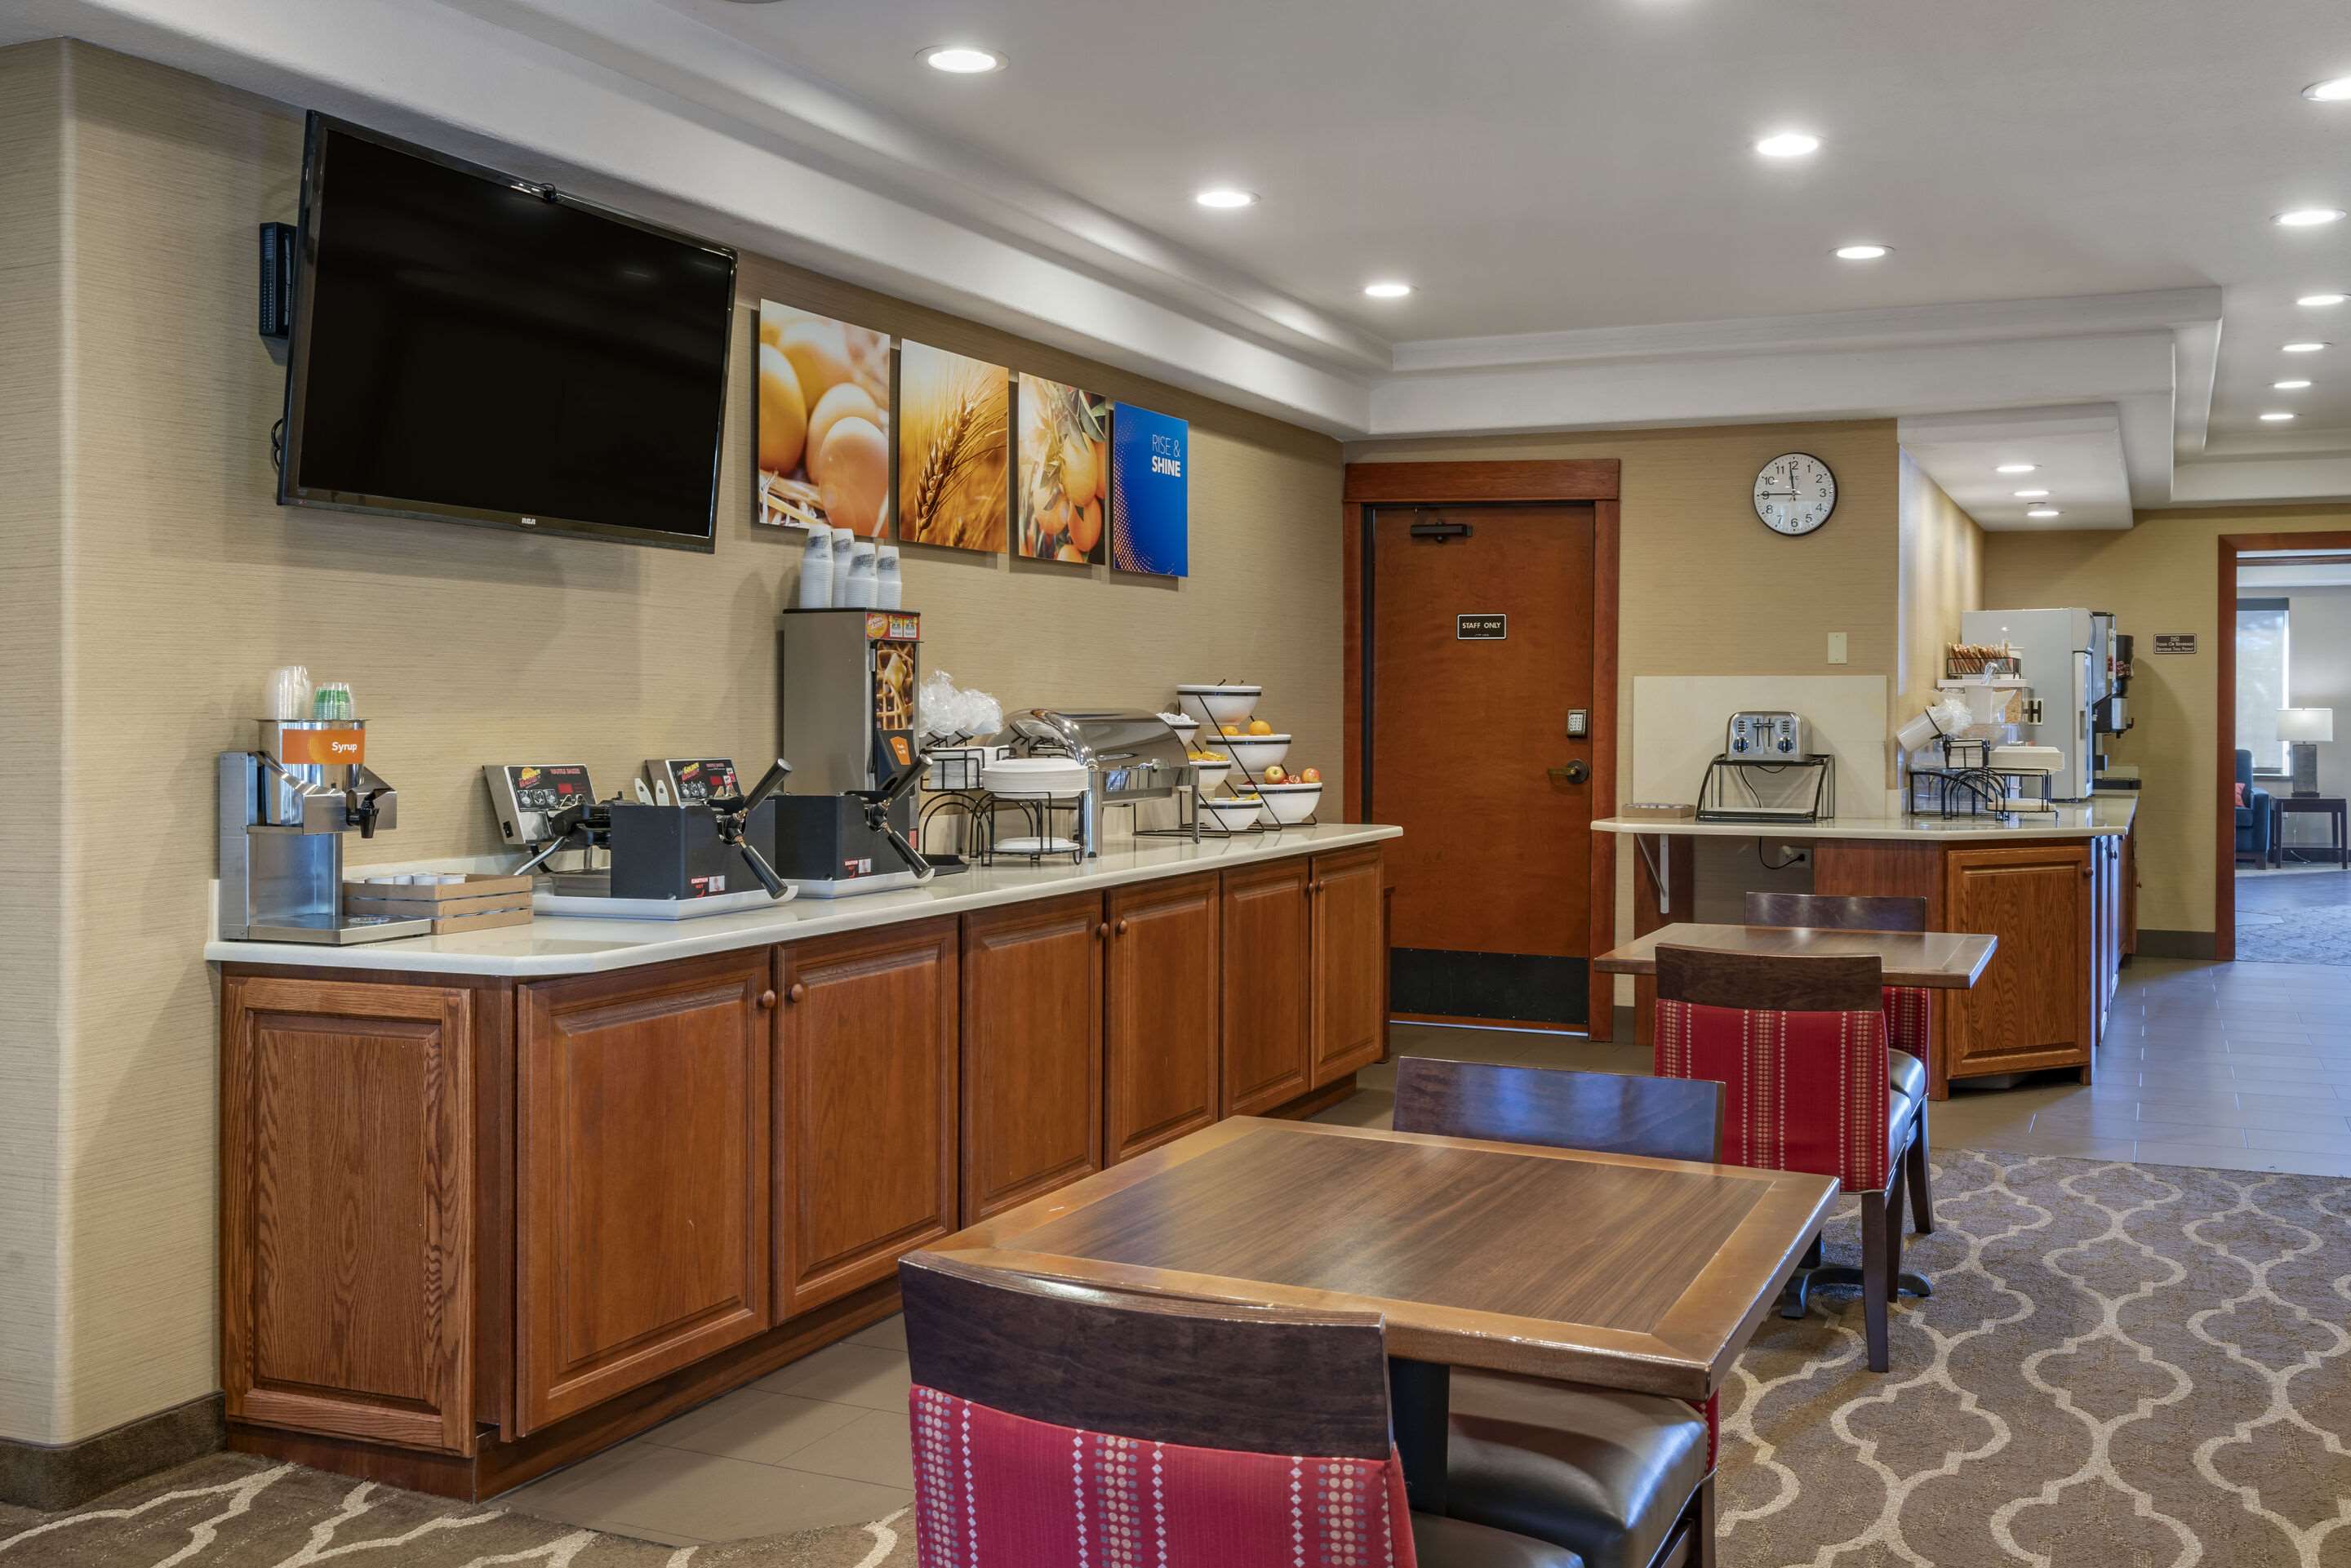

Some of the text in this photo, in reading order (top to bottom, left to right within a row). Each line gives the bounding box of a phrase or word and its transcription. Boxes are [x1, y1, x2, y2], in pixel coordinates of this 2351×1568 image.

[1152, 434, 1180, 458] RISE &
[1152, 455, 1181, 478] SHINE
[1776, 465, 1784, 475] 11
[1789, 460, 1799, 470] 12
[1764, 476, 1775, 486] 10
[1815, 474, 1823, 483] 2
[1762, 491, 1770, 500] 9
[1819, 488, 1827, 498] 3
[1766, 504, 1774, 514] 8
[1815, 503, 1823, 512] 4
[522, 517, 536, 525] RCA
[1776, 514, 1784, 525] 7
[1790, 517, 1798, 527] 6
[1805, 513, 1813, 523] 5
[331, 741, 358, 754] Syrup
